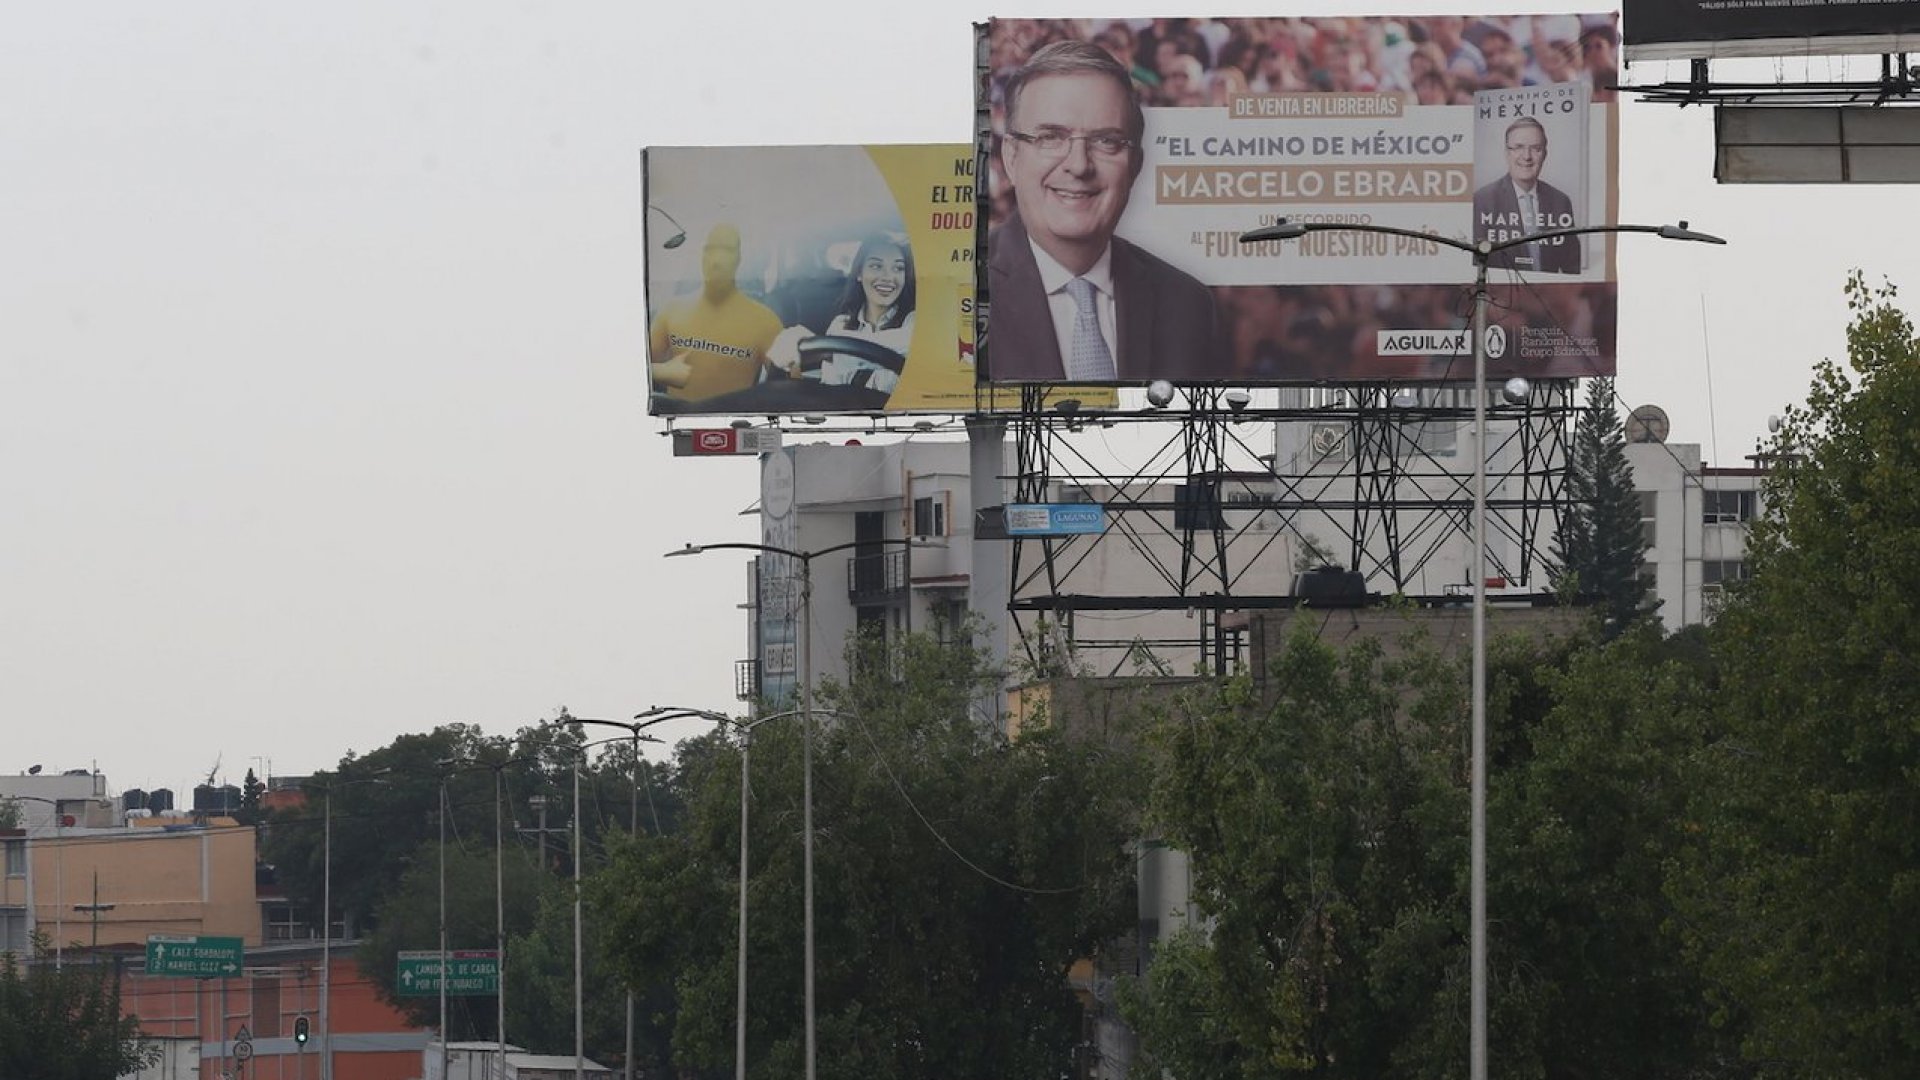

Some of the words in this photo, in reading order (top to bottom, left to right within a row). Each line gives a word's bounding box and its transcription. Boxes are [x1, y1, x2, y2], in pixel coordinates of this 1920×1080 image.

[1558, 88, 1575, 97] DE
[1235, 99, 1254, 115] DE
[1257, 98, 1299, 115] VENTA
[1303, 98, 1321, 115] EN
[1325, 94, 1398, 115] LIBRERÍAS
[1202, 136, 1306, 156] CAMINO
[1312, 136, 1345, 155] DE
[1161, 170, 1325, 198] MARCELO
[1334, 169, 1470, 197] EBRARD
[932, 186, 949, 203] EL
[1259, 214, 1278, 226] UN
[1481, 211, 1573, 227] MARCELO
[1190, 231, 1203, 245] AL
[1205, 231, 1282, 257] FUTURO
[1299, 228, 1388, 257] NUESTRO
[1396, 225, 1439, 256] PAÍS
[951, 250, 959, 262] A
[670, 334, 754, 359] Sedalmerck
[1384, 335, 1466, 350] AGUILAR
[1520, 336, 1564, 346] Random
[1520, 347, 1552, 358] Grupo
